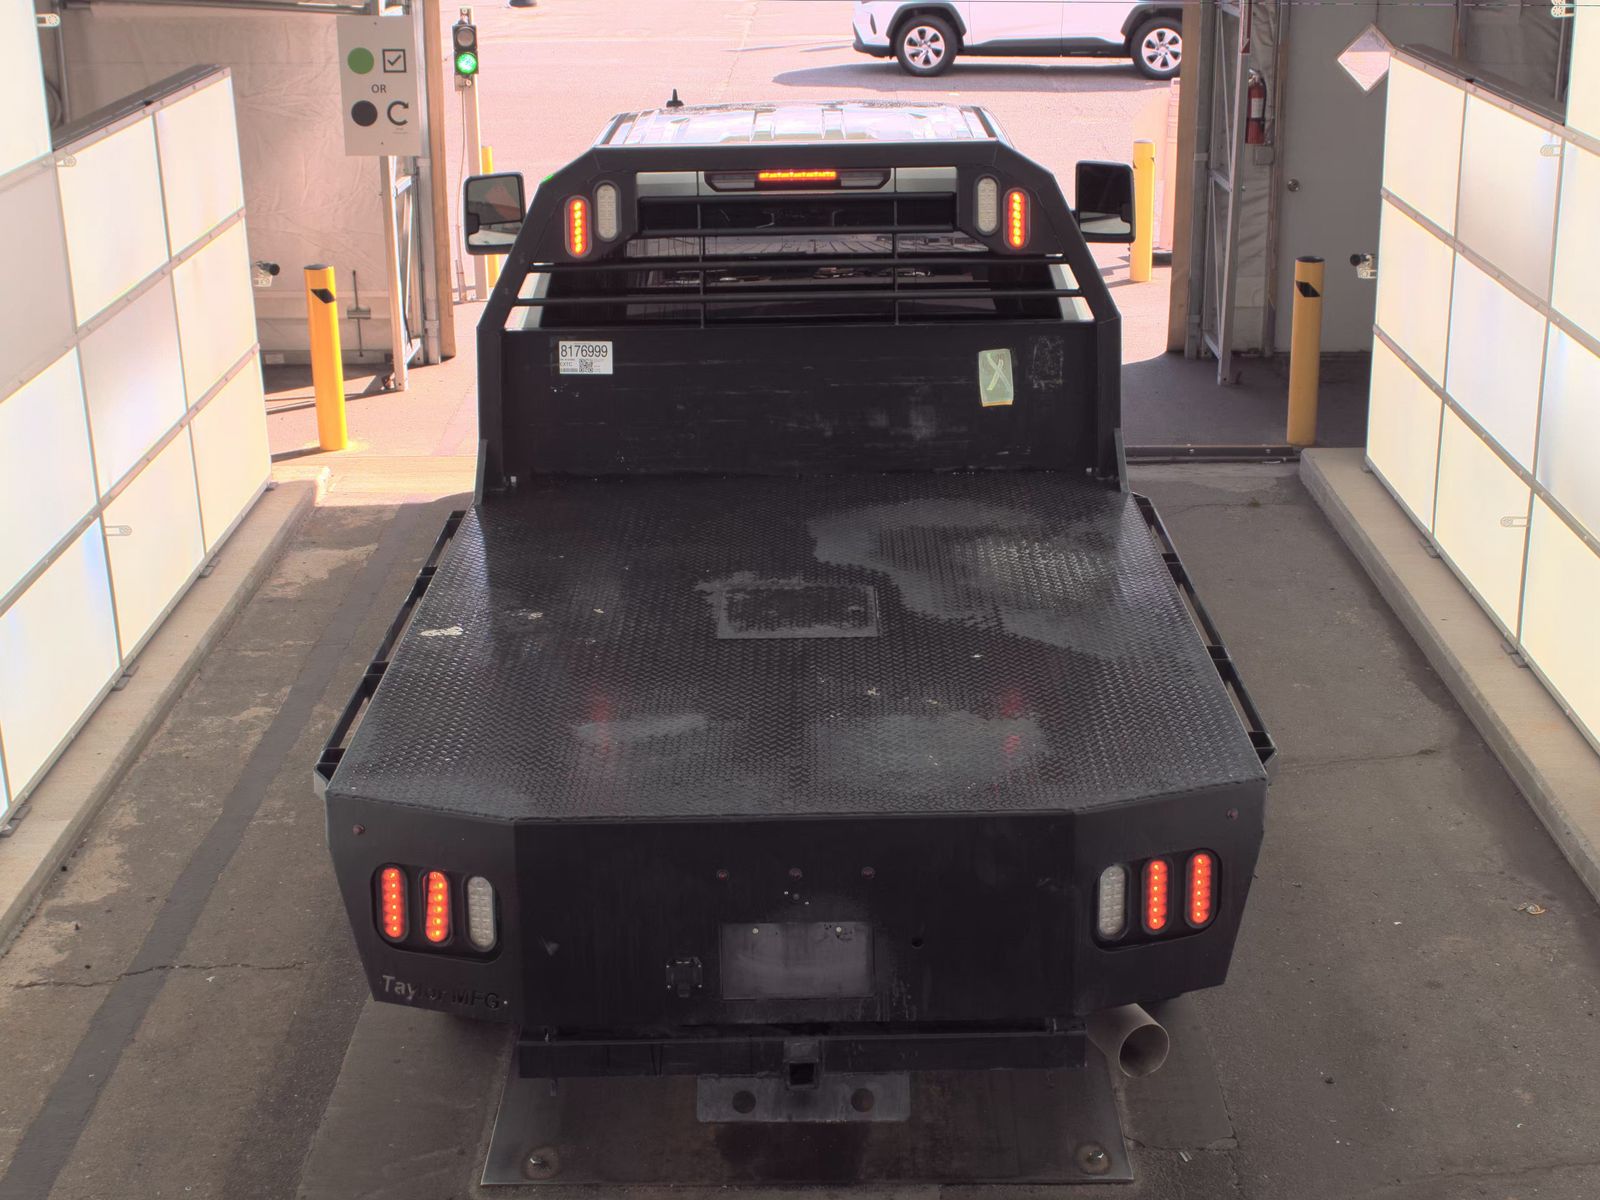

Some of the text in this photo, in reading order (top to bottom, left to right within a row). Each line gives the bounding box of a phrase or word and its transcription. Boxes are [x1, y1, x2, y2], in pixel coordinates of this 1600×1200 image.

[371, 84, 387, 94] OR
[560, 344, 608, 358] 8176999
[382, 974, 448, 1001] Taylor
